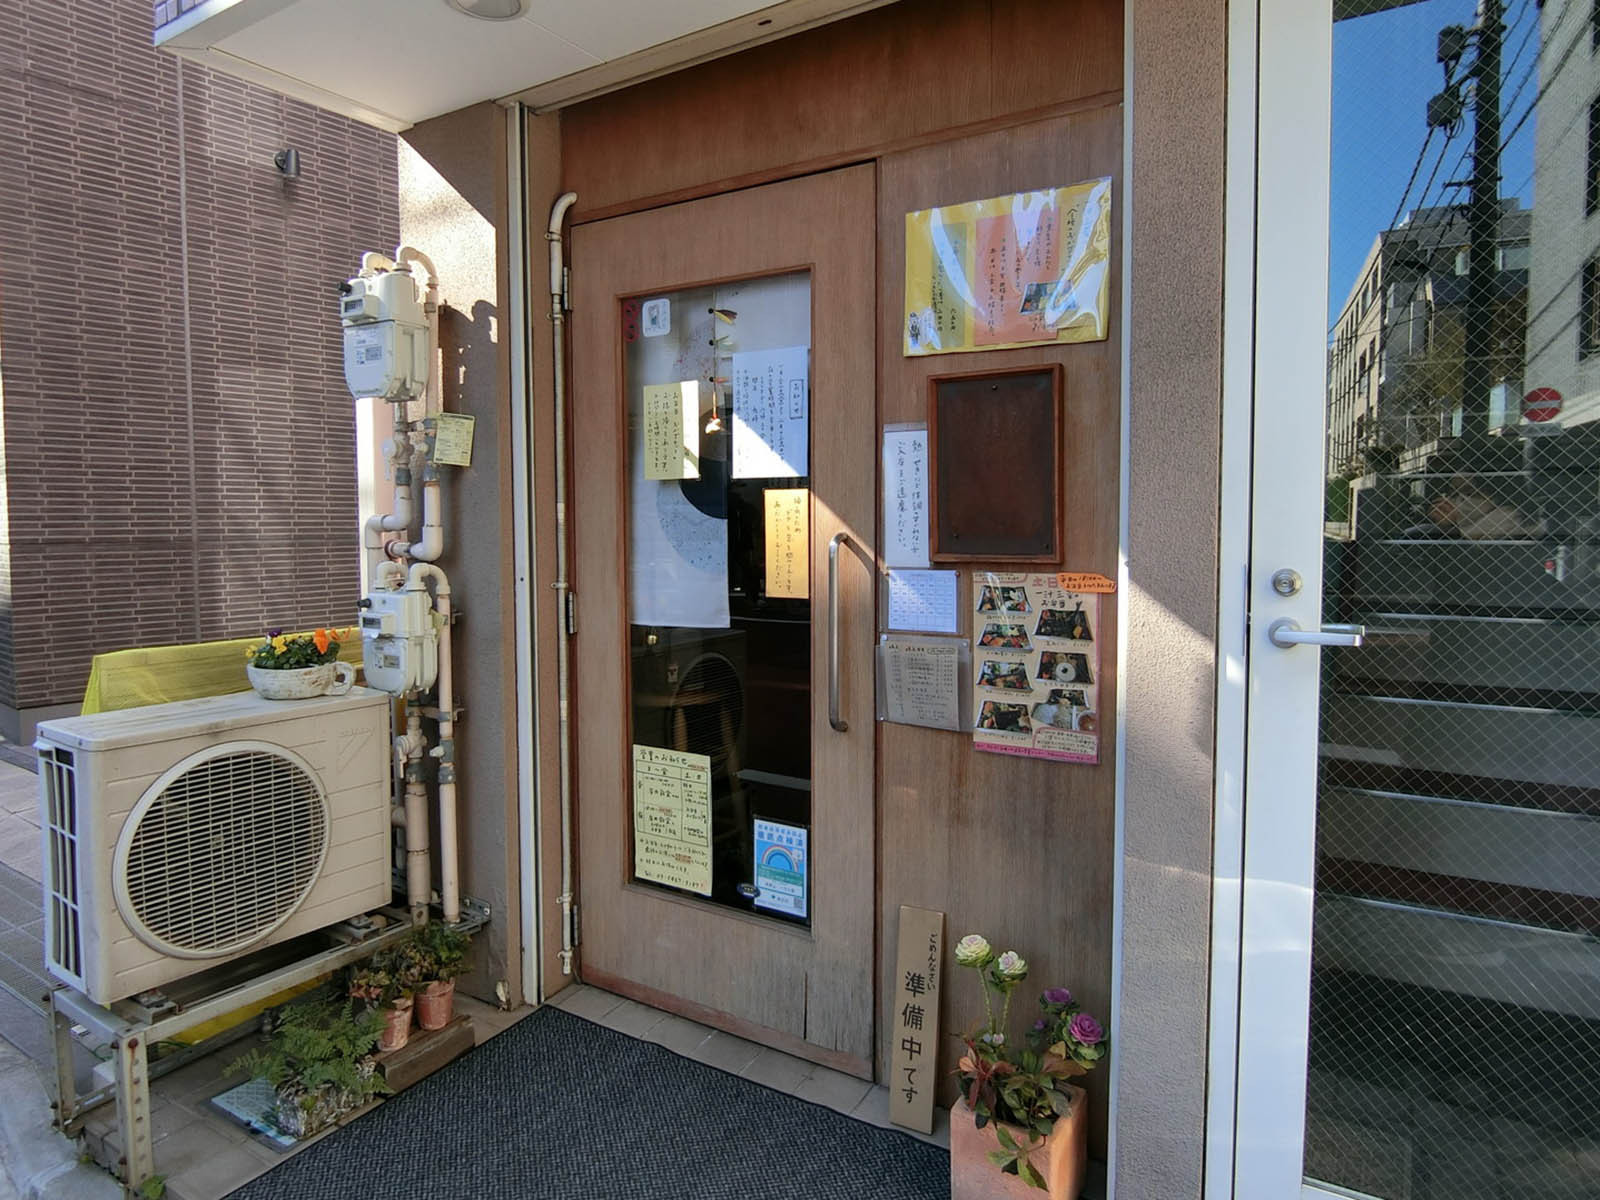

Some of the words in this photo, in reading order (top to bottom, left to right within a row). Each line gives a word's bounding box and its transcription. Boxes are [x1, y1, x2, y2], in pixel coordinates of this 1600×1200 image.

[926, 932, 938, 992] ごめんなさい
